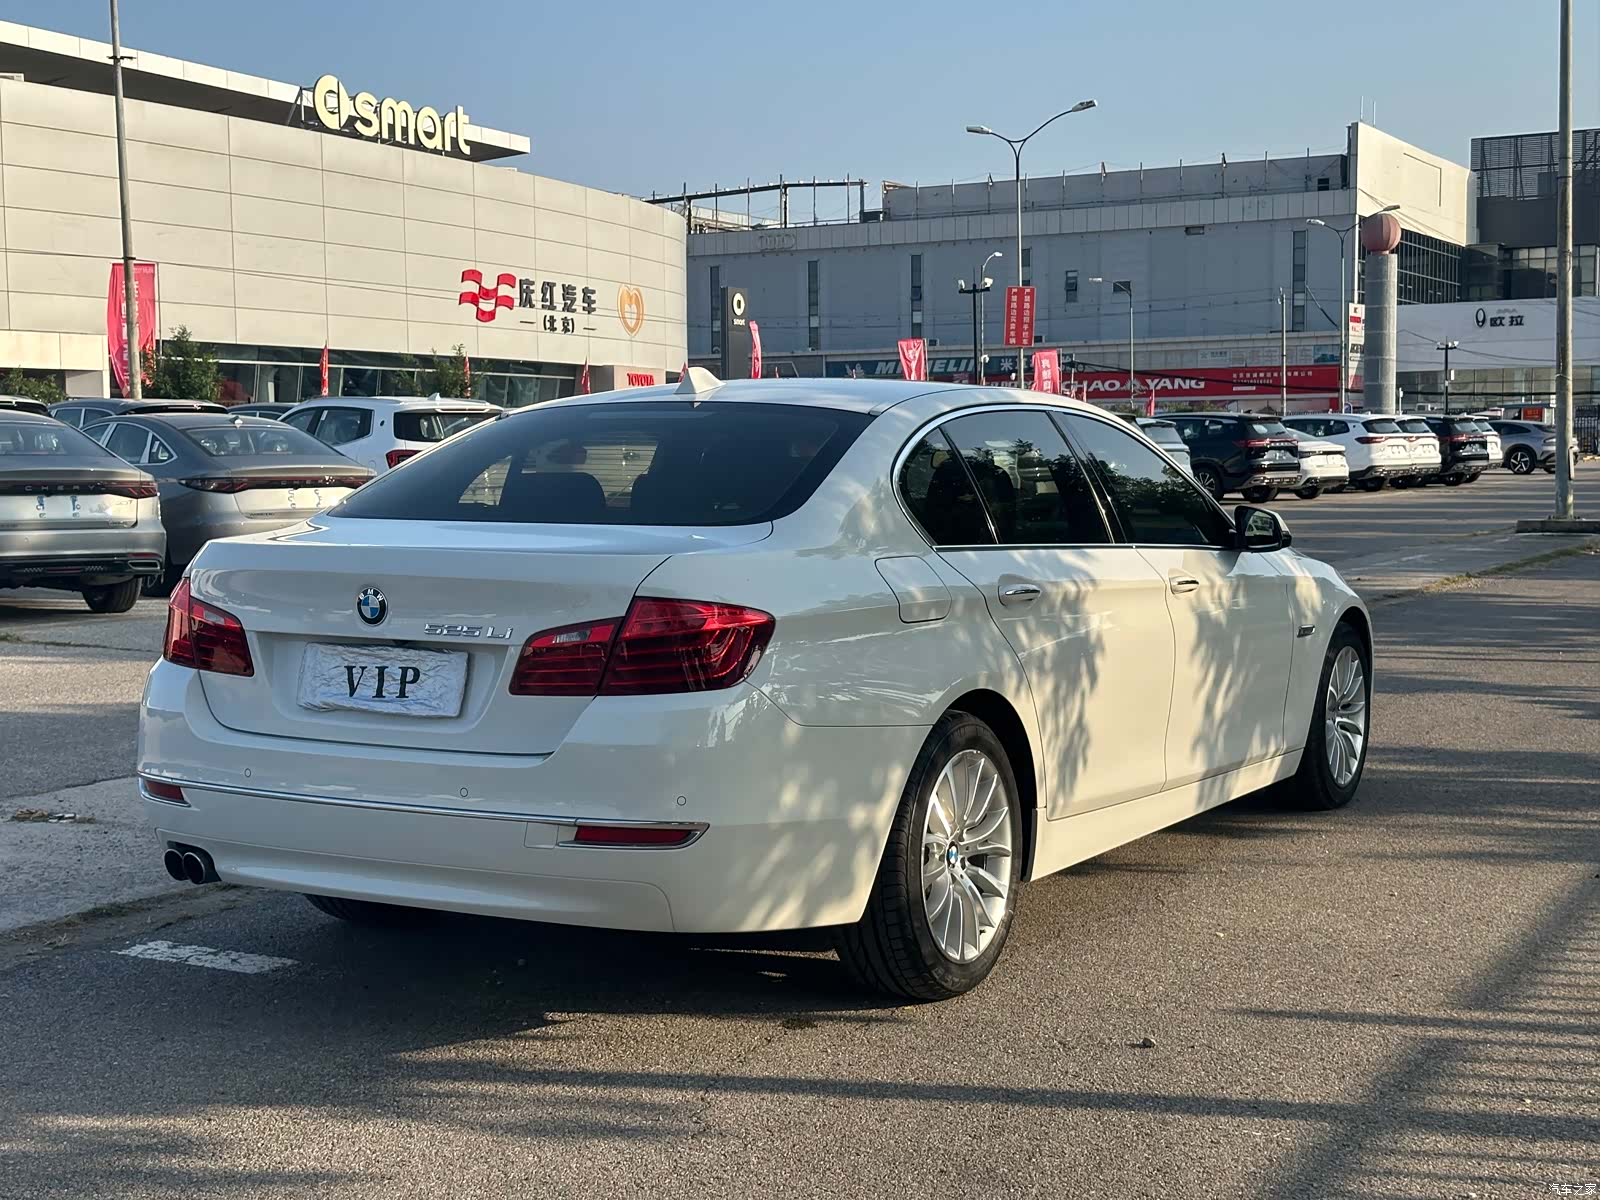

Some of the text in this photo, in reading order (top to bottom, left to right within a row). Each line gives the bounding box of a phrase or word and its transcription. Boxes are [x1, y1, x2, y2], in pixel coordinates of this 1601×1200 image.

[353, 91, 471, 156] smart
[519, 278, 597, 315] 庆红汽车
[1489, 314, 1525, 327] 欧拉
[626, 372, 655, 387] TOYOTA
[1145, 376, 1206, 390] YANG
[24, 484, 95, 492] CHERY
[343, 664, 421, 699] VIP
